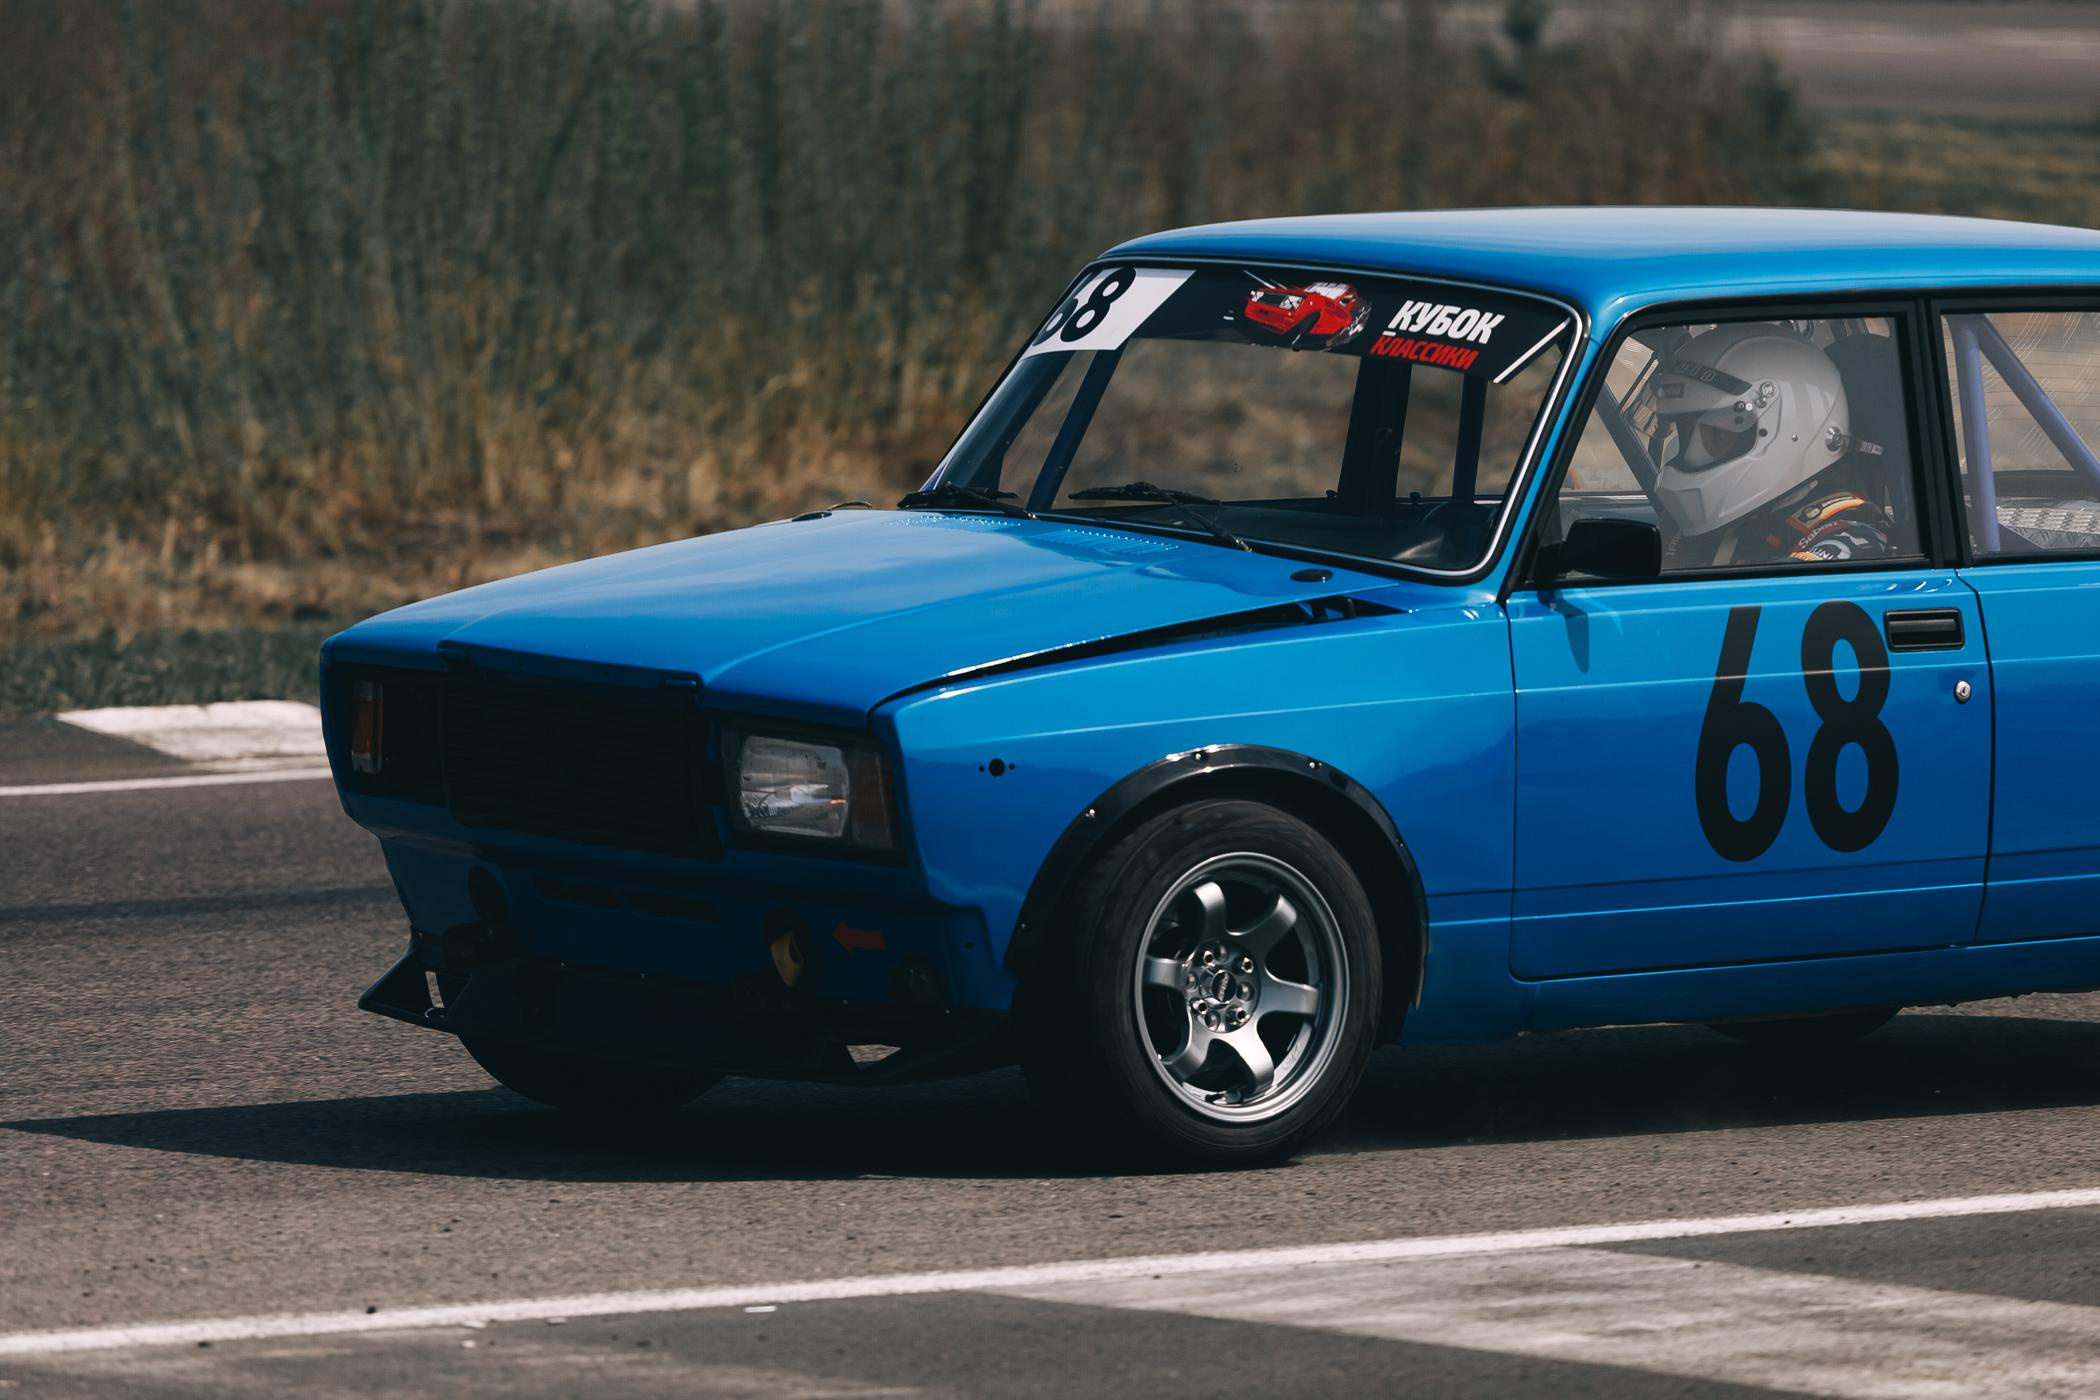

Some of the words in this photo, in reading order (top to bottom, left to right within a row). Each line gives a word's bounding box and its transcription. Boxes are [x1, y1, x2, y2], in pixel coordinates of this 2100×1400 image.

[1387, 300, 1505, 344] КУБОК
[1370, 336, 1479, 370] КЛАССИКИ
[1695, 600, 1900, 862] 68
